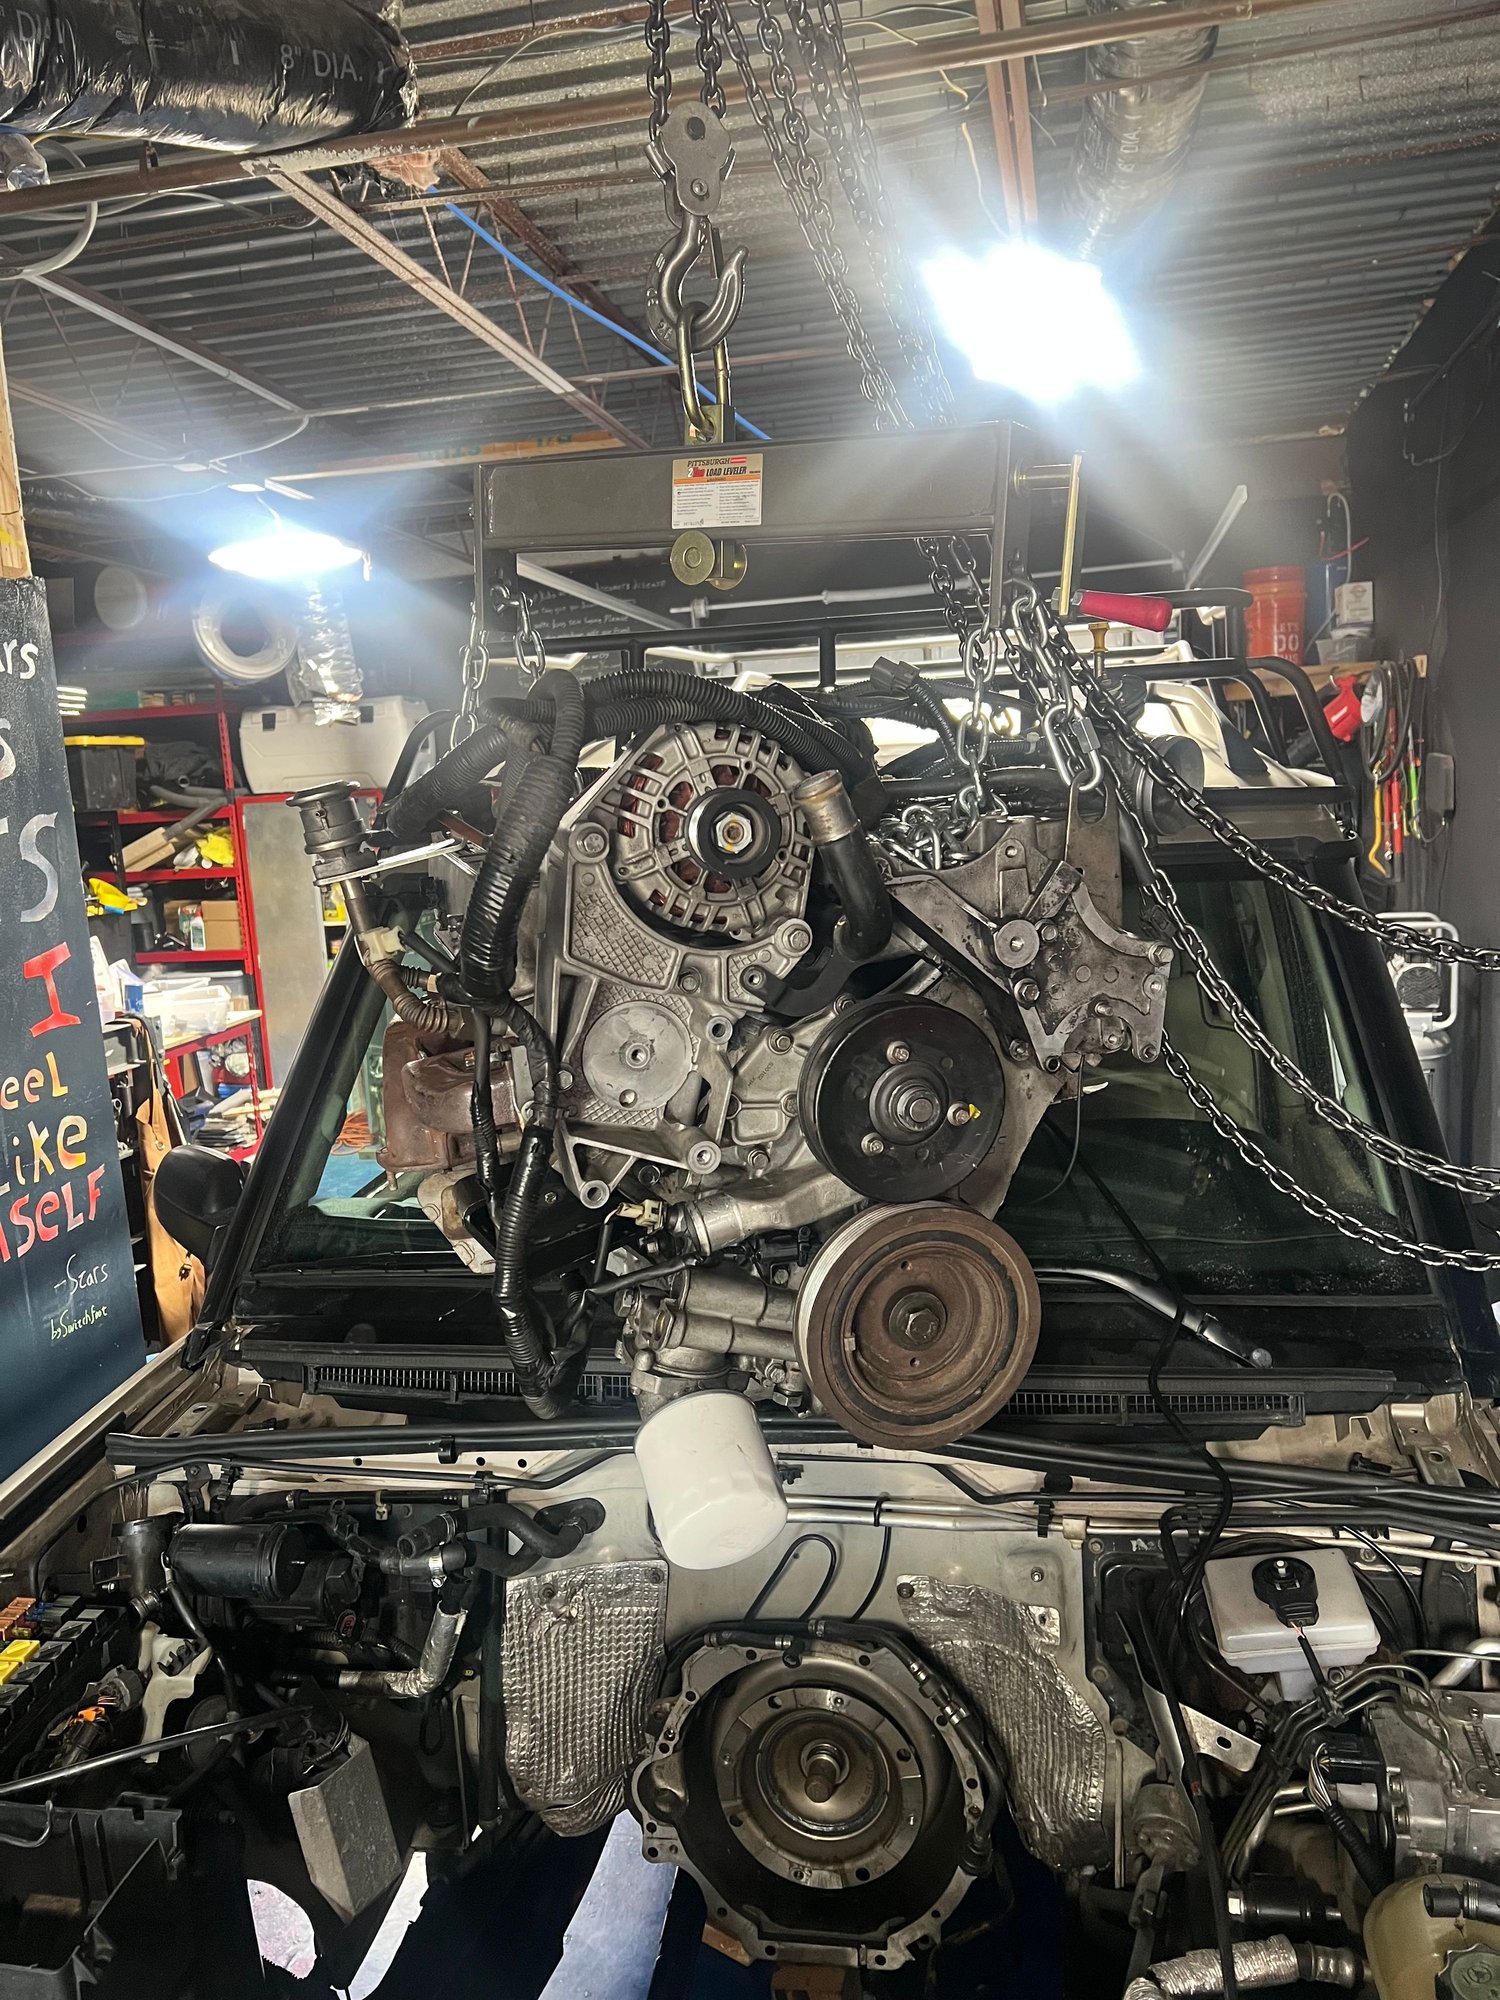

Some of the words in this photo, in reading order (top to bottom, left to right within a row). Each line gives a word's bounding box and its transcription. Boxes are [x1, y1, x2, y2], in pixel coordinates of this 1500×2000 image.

[280, 44, 301, 69] 8"
[312, 49, 363, 82] DIA.
[687, 458, 730, 467] PITTSBURGH
[706, 468, 722, 477] LOAD
[723, 466, 747, 476] LEVELER
[0, 639, 38, 679] rs
[23, 941, 81, 1037] I
